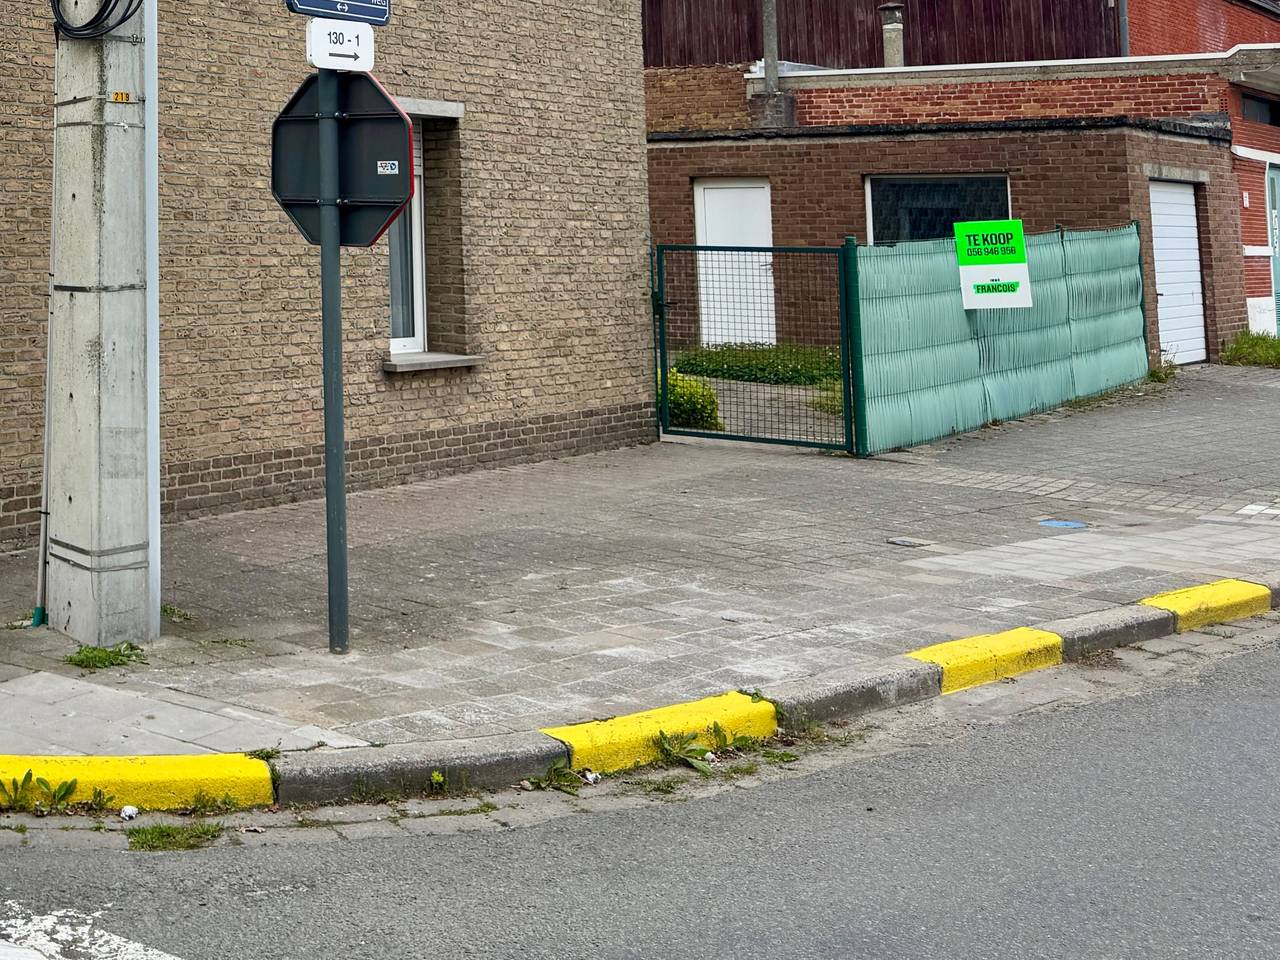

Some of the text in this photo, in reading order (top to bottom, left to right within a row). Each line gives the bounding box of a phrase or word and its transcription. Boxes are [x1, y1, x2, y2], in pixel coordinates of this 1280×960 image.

[327, 31, 345, 45] 130
[355, 34, 360, 47] 1
[965, 233, 1013, 246] TE KOOP
[976, 283, 1016, 294] FRANCOIS
